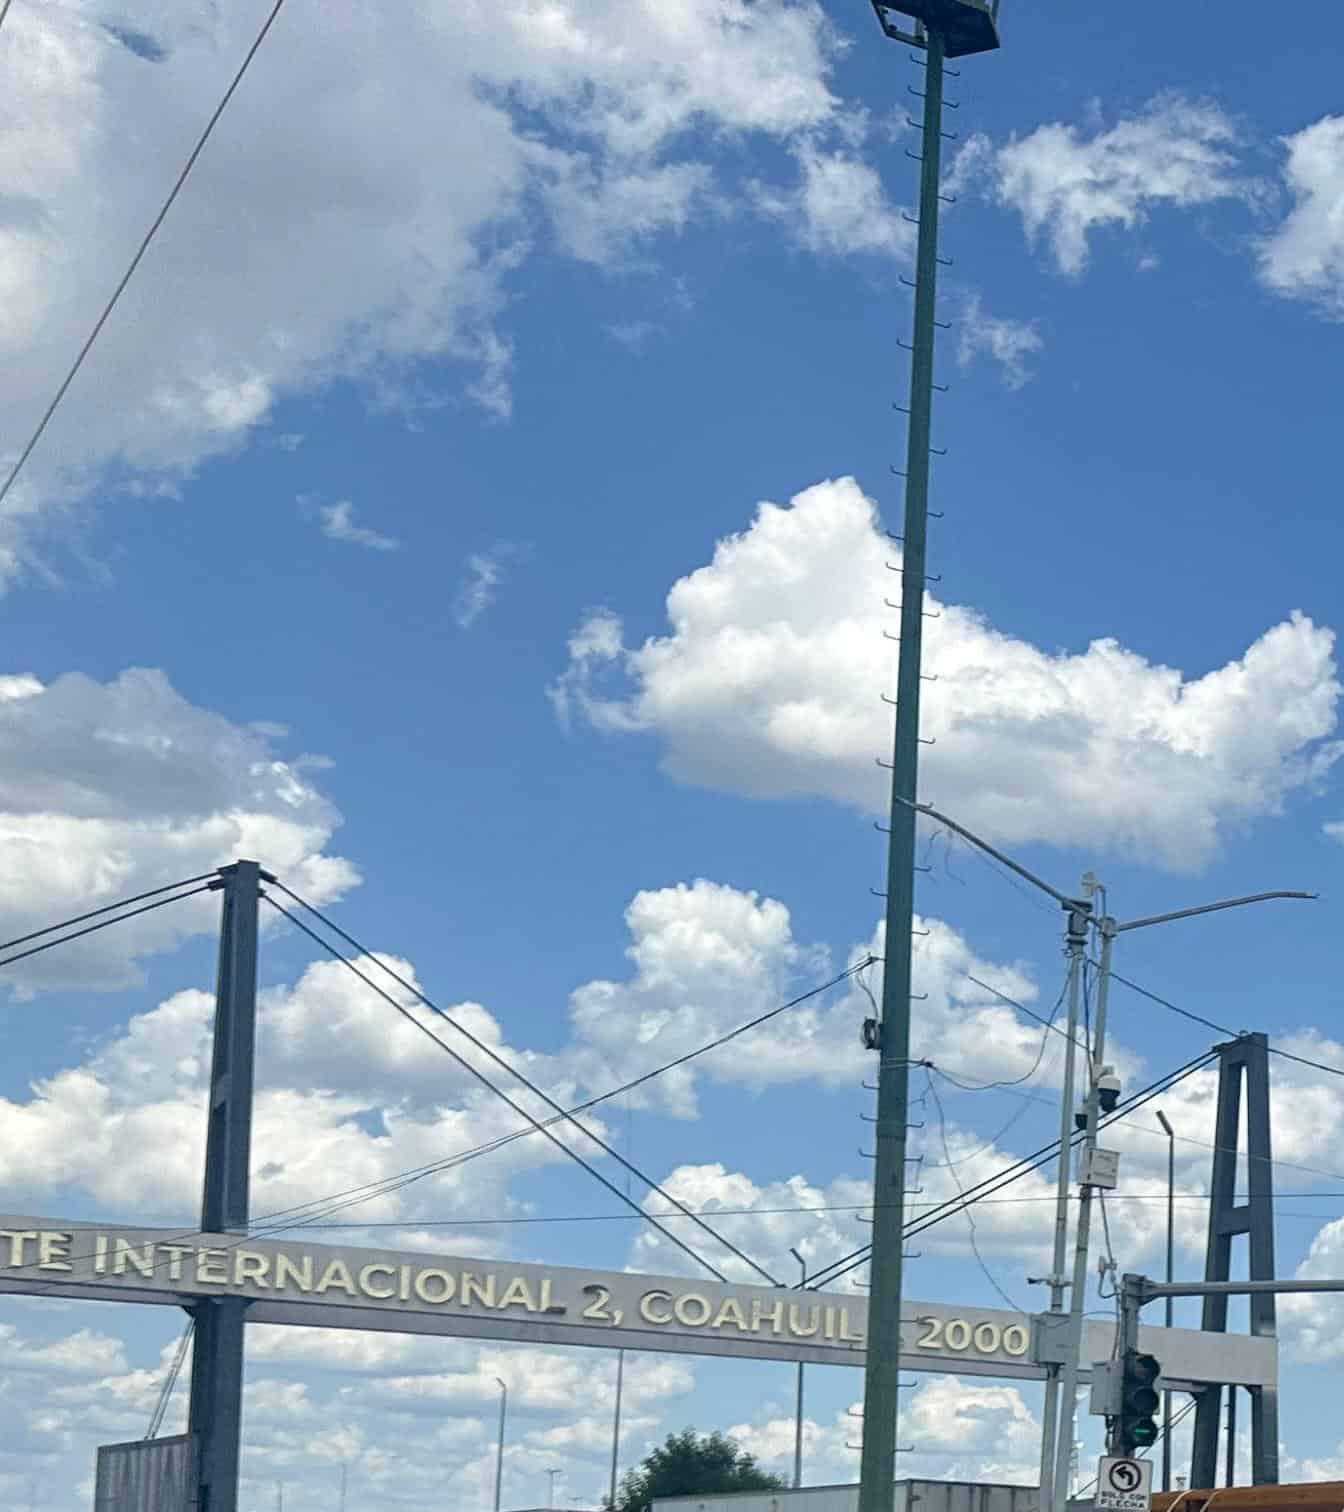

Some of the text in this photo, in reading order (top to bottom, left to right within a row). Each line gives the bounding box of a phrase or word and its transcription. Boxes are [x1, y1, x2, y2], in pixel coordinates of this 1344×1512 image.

[94, 1236, 566, 1313] INTERNACIONAL
[582, 1284, 623, 1327] 2,
[638, 1288, 867, 1344] COAHUIL
[915, 1315, 1031, 1356] 2000
